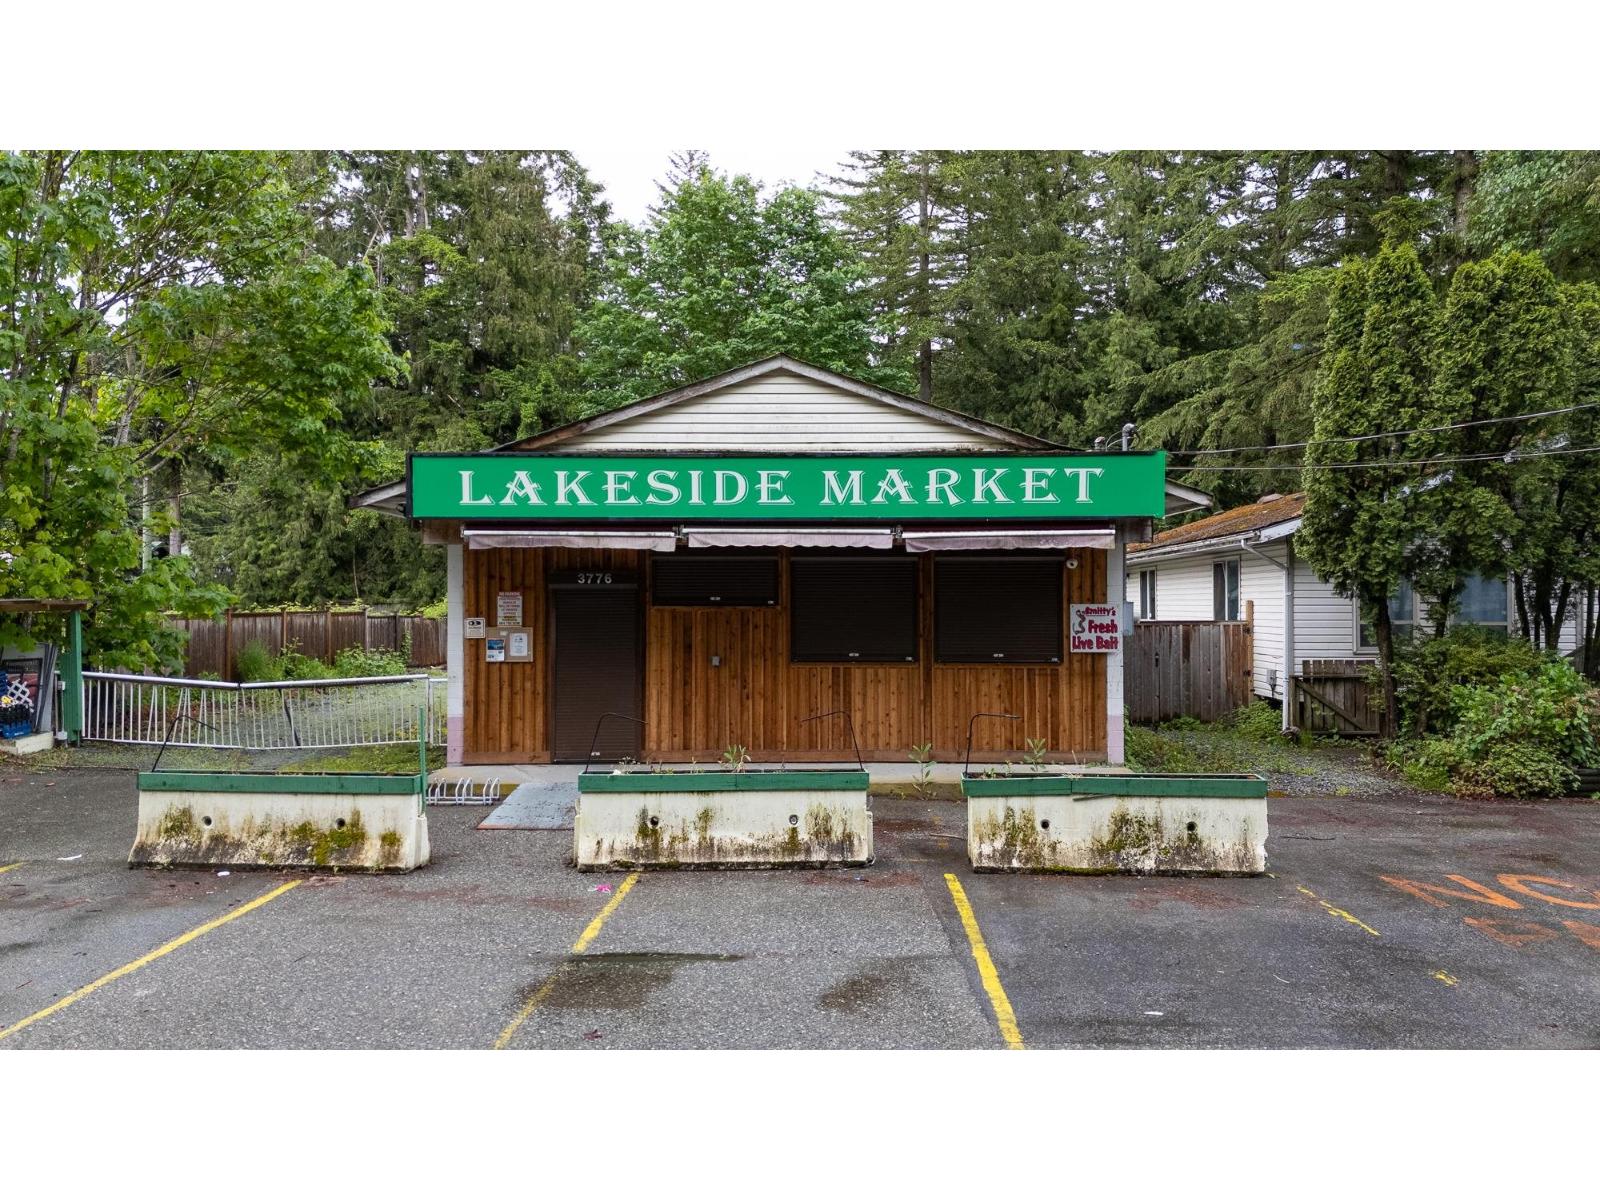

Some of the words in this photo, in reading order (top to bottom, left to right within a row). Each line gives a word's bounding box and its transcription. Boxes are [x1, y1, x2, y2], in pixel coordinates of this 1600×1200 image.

[458, 470, 795, 506] LAKESIDE
[819, 468, 1105, 507] MARKET
[577, 573, 612, 584] 3776
[1088, 619, 1118, 634] Fresh
[1072, 635, 1094, 650] Live
[1096, 635, 1118, 650] Bait
